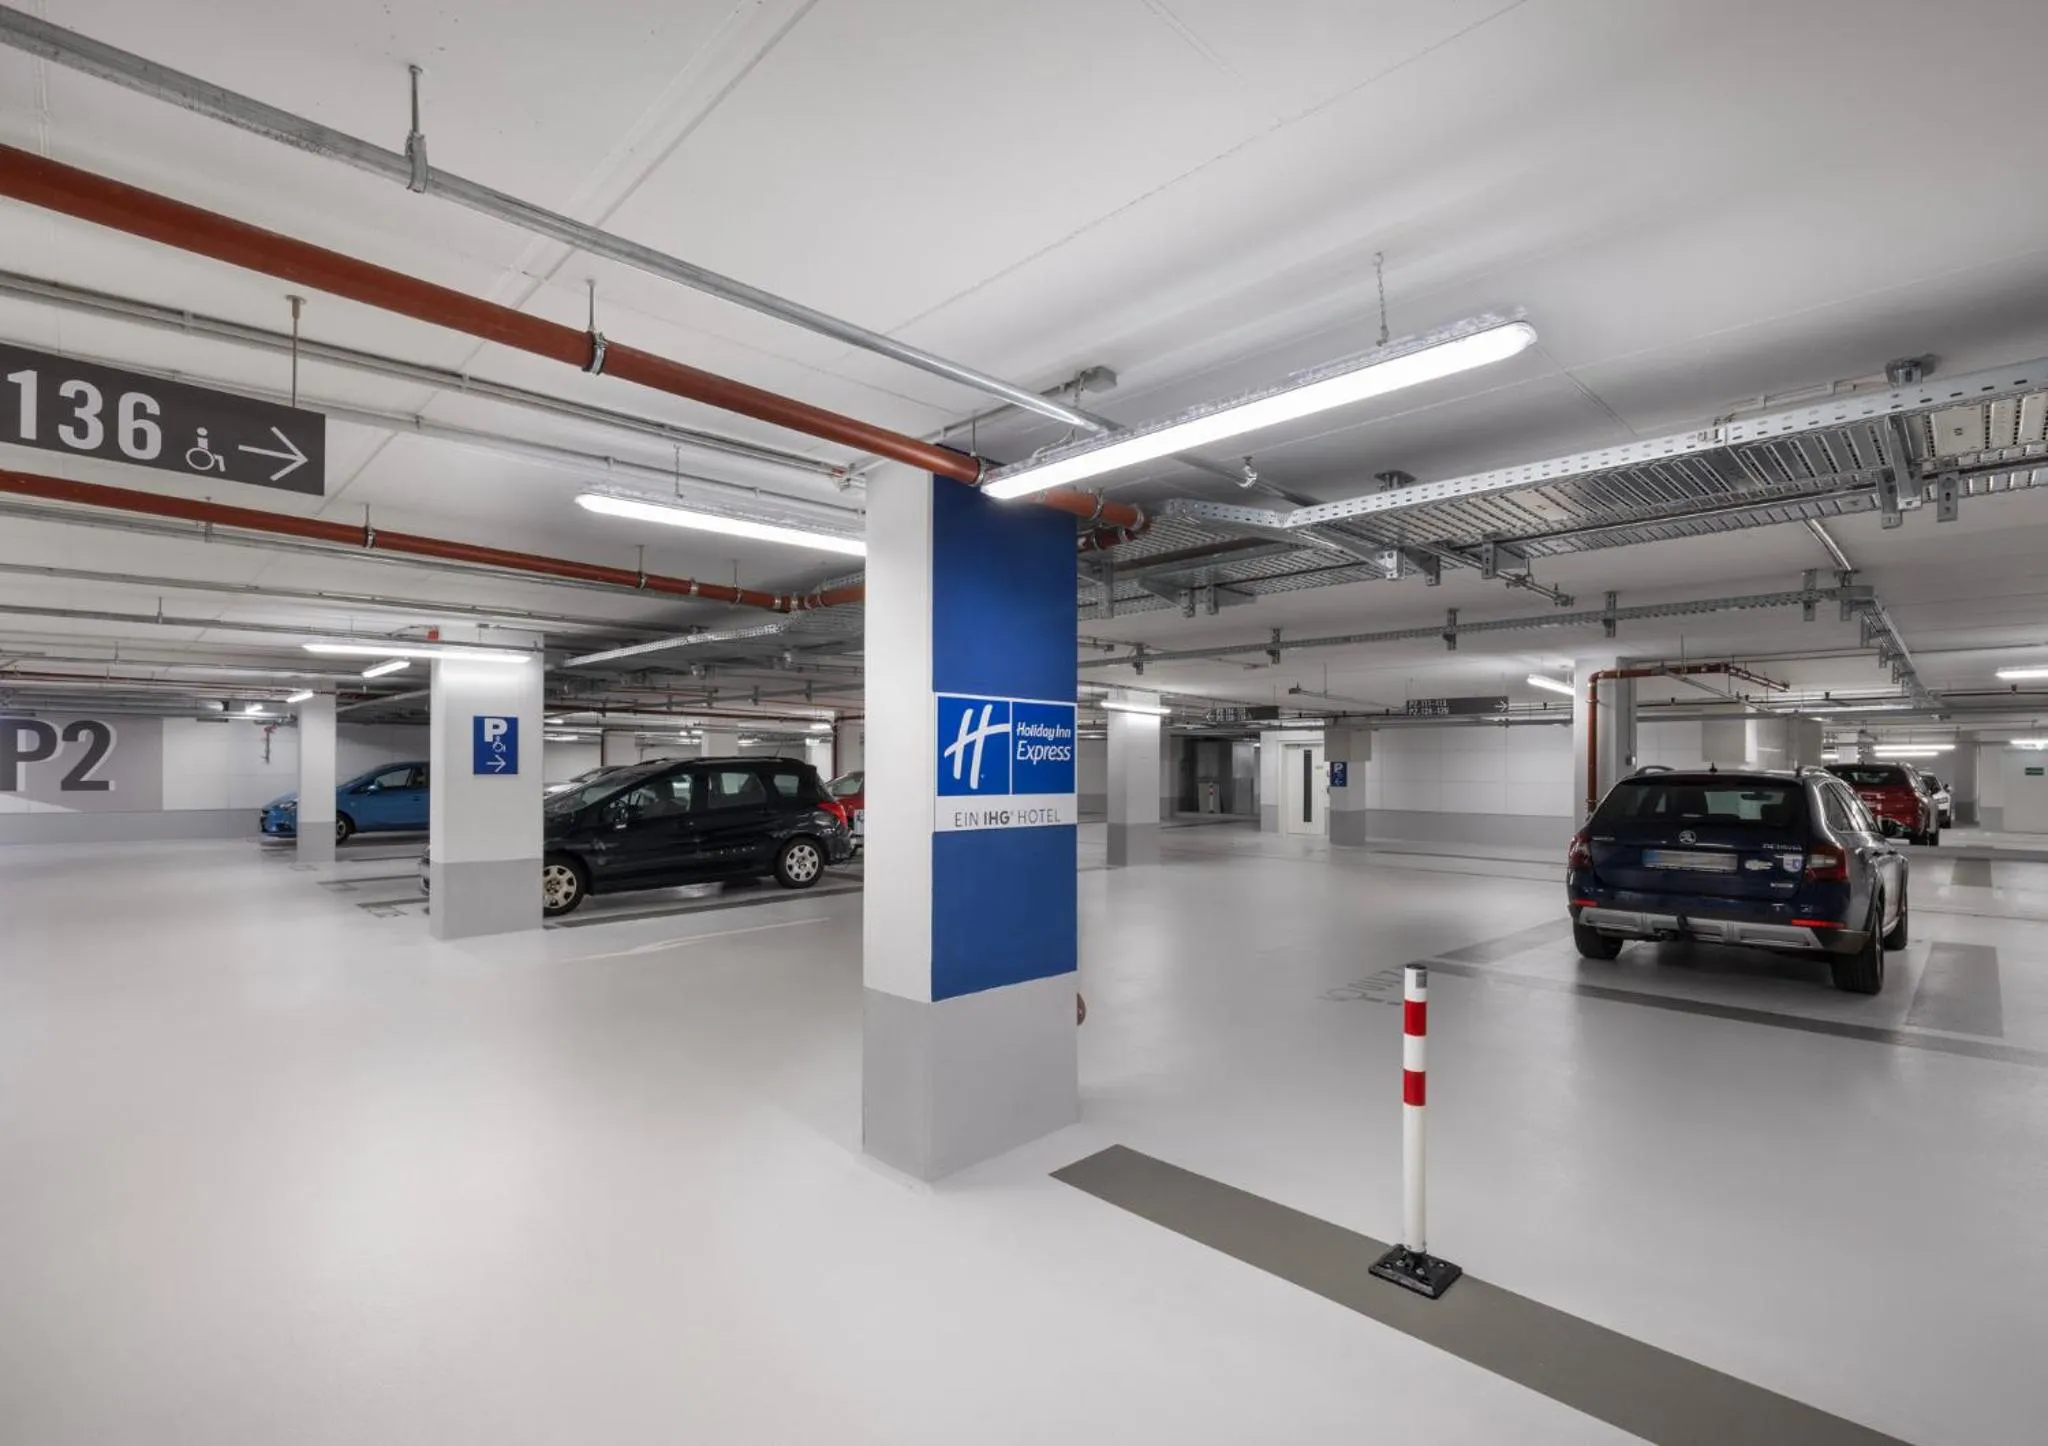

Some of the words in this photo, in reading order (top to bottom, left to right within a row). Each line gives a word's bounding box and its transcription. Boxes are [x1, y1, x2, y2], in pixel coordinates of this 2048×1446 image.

[7, 369, 162, 460] 136
[484, 718, 508, 742] P
[1016, 721, 1055, 741] Holiday
[1056, 723, 1072, 738] Inn
[0, 719, 113, 792] P2
[1016, 740, 1072, 765] Express
[954, 811, 979, 828] EIN
[1017, 808, 1061, 825] HOTEL
